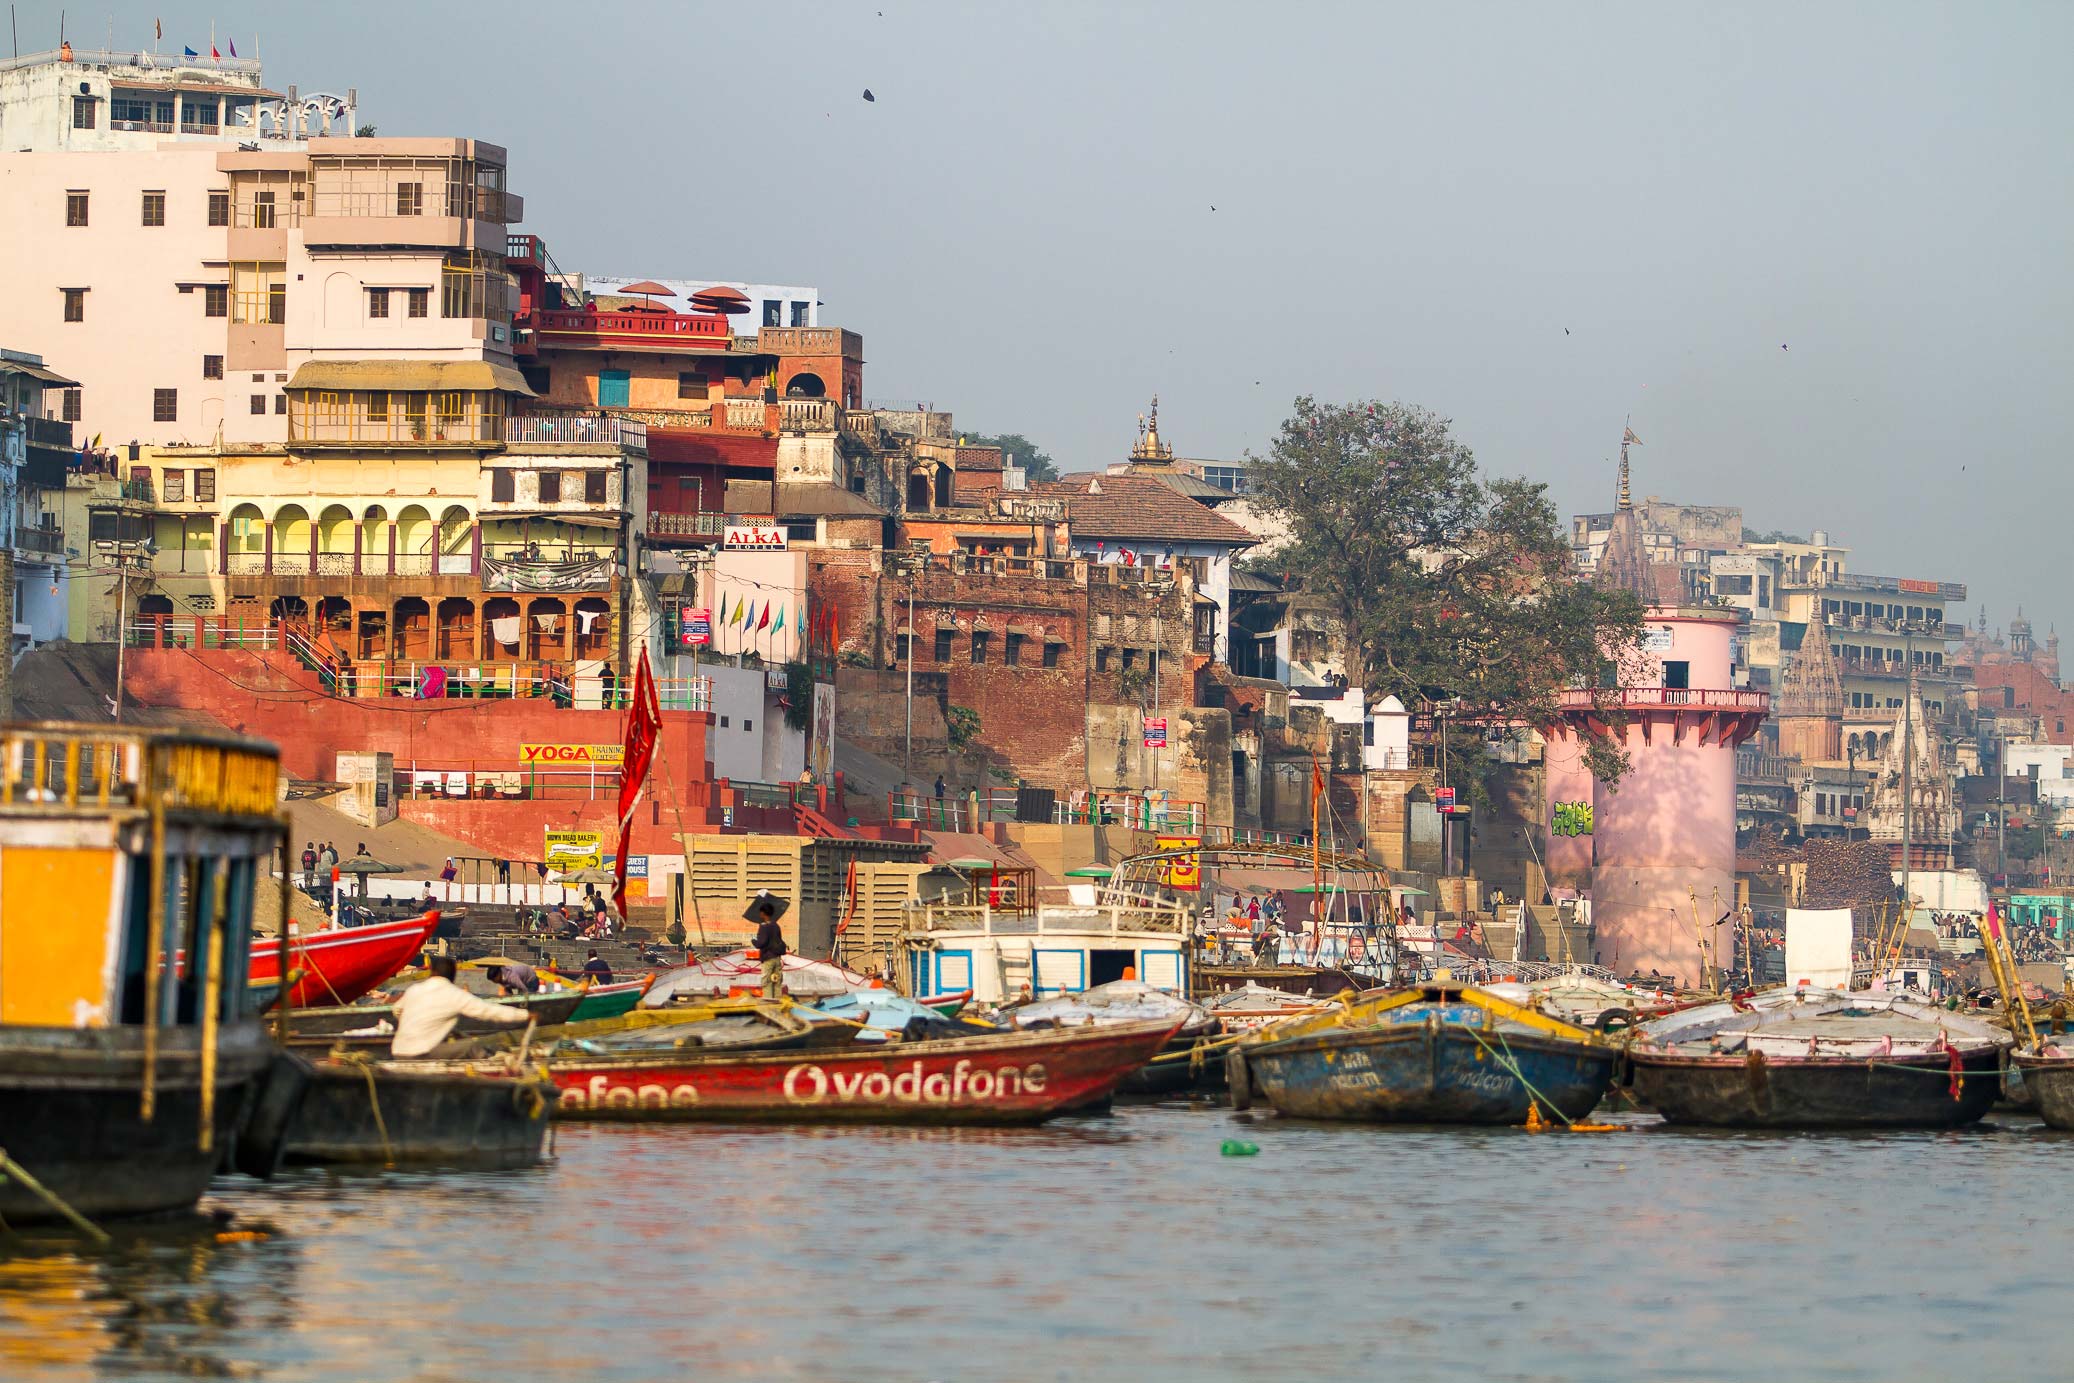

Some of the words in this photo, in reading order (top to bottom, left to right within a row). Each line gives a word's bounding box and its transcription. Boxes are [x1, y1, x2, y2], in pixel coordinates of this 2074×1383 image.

[728, 531, 783, 544] ALKA
[525, 746, 591, 761] YOGA
[591, 746, 624, 754] TRAINING
[833, 1059, 1046, 1102] vodafone
[558, 1075, 700, 1110] afone
